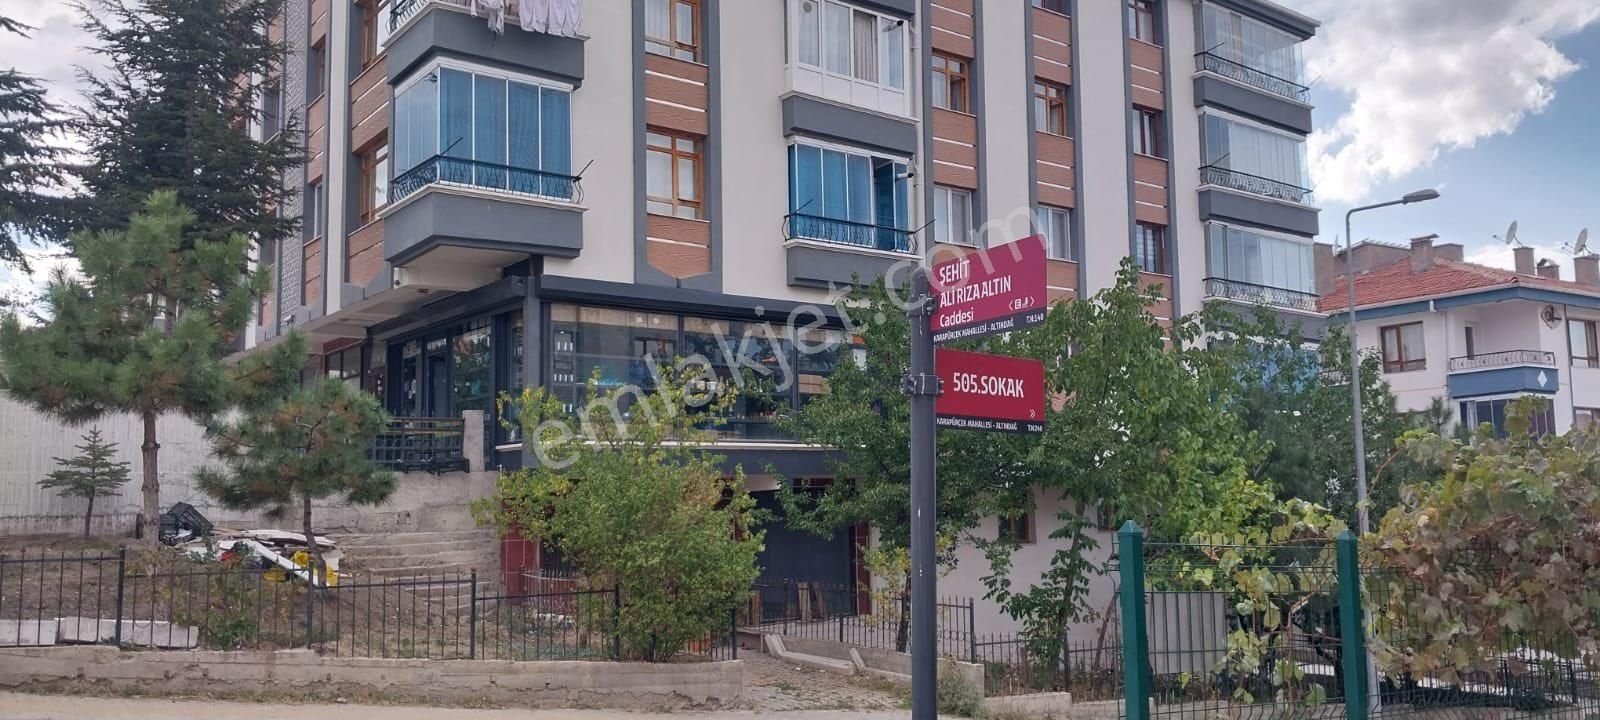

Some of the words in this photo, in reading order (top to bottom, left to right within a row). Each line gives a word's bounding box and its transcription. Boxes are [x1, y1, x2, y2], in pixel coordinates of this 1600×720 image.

[940, 258, 970, 286] ŞEHİT
[940, 285, 955, 308] ALİ
[957, 282, 980, 304] RIZA
[981, 275, 1012, 298] ALTIN
[933, 329, 962, 343] KARAPÜRÇEK
[962, 323, 987, 338] MAHALLESİ
[990, 317, 1014, 332] ALTINDAĞ
[940, 307, 974, 328] Caddesi
[953, 372, 1025, 398] 505.SOKAK
[936, 416, 967, 428] KARAPÜRÇEK
[967, 419, 992, 429] MAHALLESİ
[996, 421, 1018, 431] ALTINDAĞ
